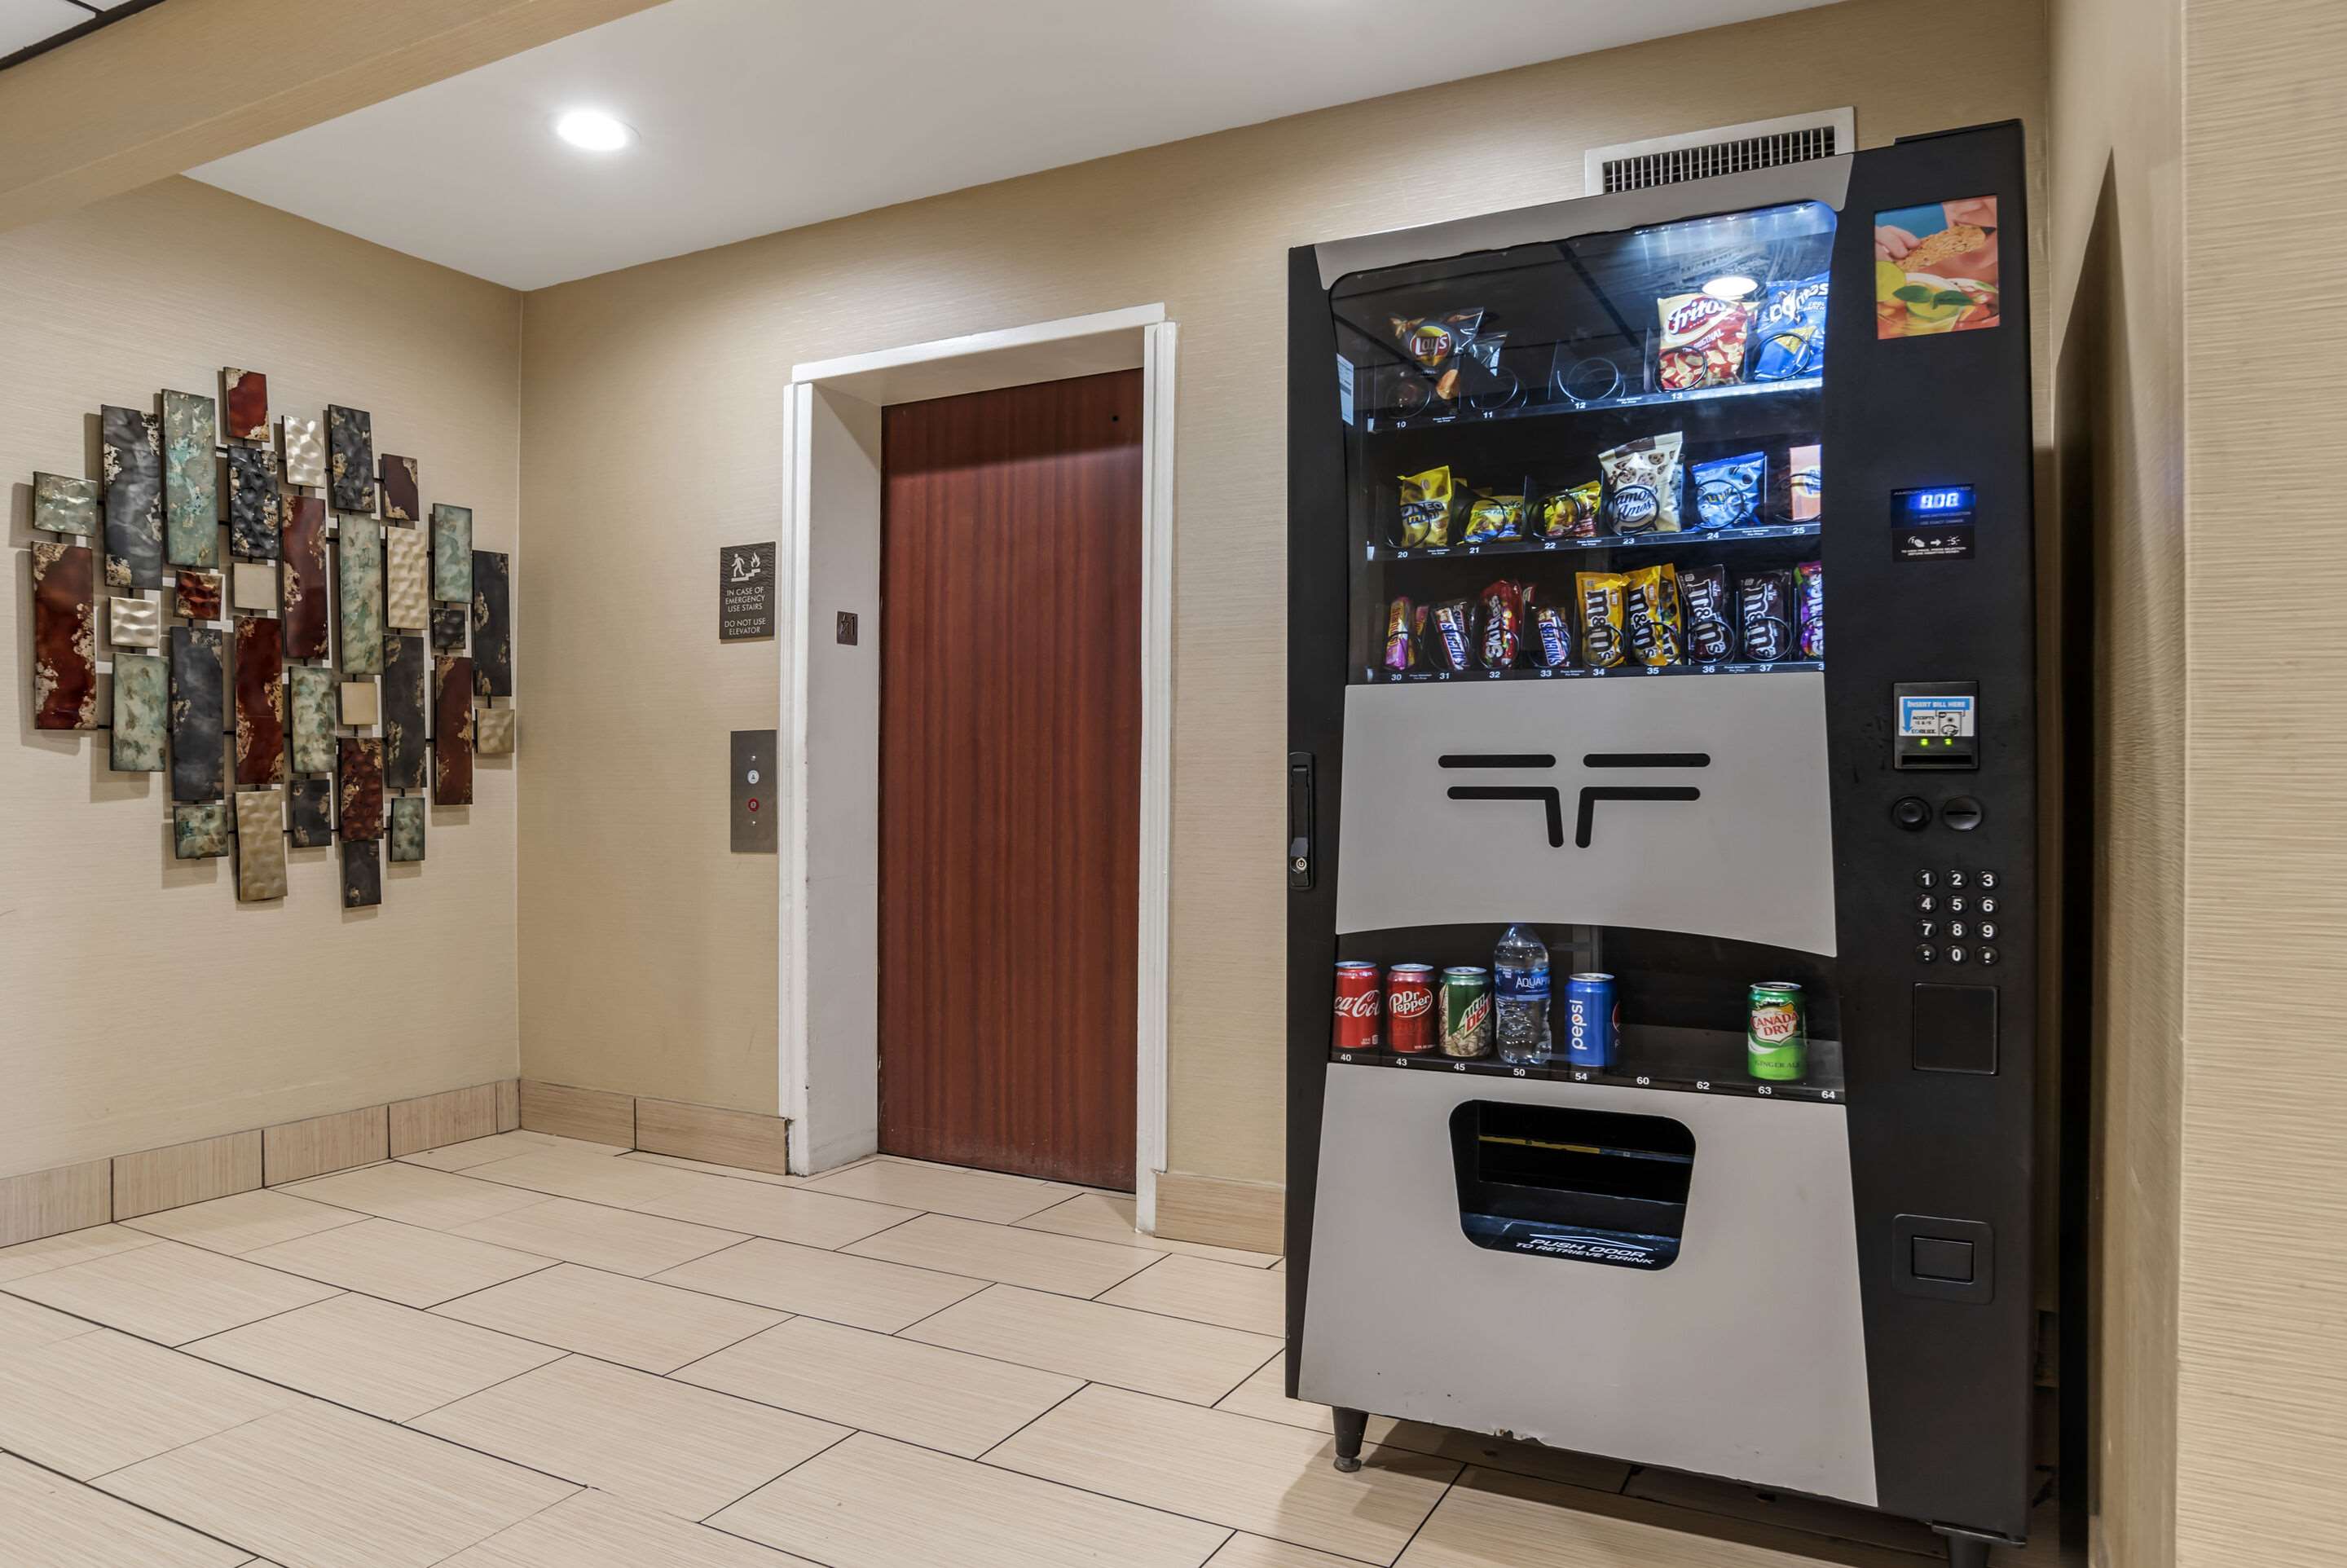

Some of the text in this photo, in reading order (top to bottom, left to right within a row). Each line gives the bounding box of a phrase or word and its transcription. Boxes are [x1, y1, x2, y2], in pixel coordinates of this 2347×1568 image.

[1668, 299, 1726, 334] Fritos
[736, 587, 754, 596] CASE
[754, 586, 764, 594] OF
[725, 594, 766, 605] EMERGENCY
[742, 603, 763, 611] STAIRS
[724, 618, 766, 628] DO NOT USE
[729, 627, 761, 636] ELEVATOR
[1540, 623, 1562, 666] SNICKERS
[1922, 873, 1994, 887] 1 2 3
[1921, 897, 1994, 912] 4 5 6
[1922, 923, 1994, 937] 7 8 9
[1951, 949, 1962, 962] 0
[1402, 990, 1420, 1004] Dr
[1390, 993, 1431, 1015] Pepper
[1570, 999, 1587, 1050] pepsi
[1750, 1011, 1800, 1030] CANADA
[1763, 1023, 1791, 1037] DRY
[1396, 1058, 1407, 1066] 43
[1513, 1068, 1526, 1077] 50
[1575, 1072, 1587, 1081] 54
[1636, 1077, 1649, 1085] 60
[1696, 1081, 1710, 1090] 62
[1758, 1086, 1772, 1095] 63
[1821, 1090, 1835, 1099] 64
[1530, 1239, 1646, 1257] PUSH DOOR
[1535, 1245, 1603, 1257] RETRIEVE
[1605, 1254, 1655, 1264] DRINK
